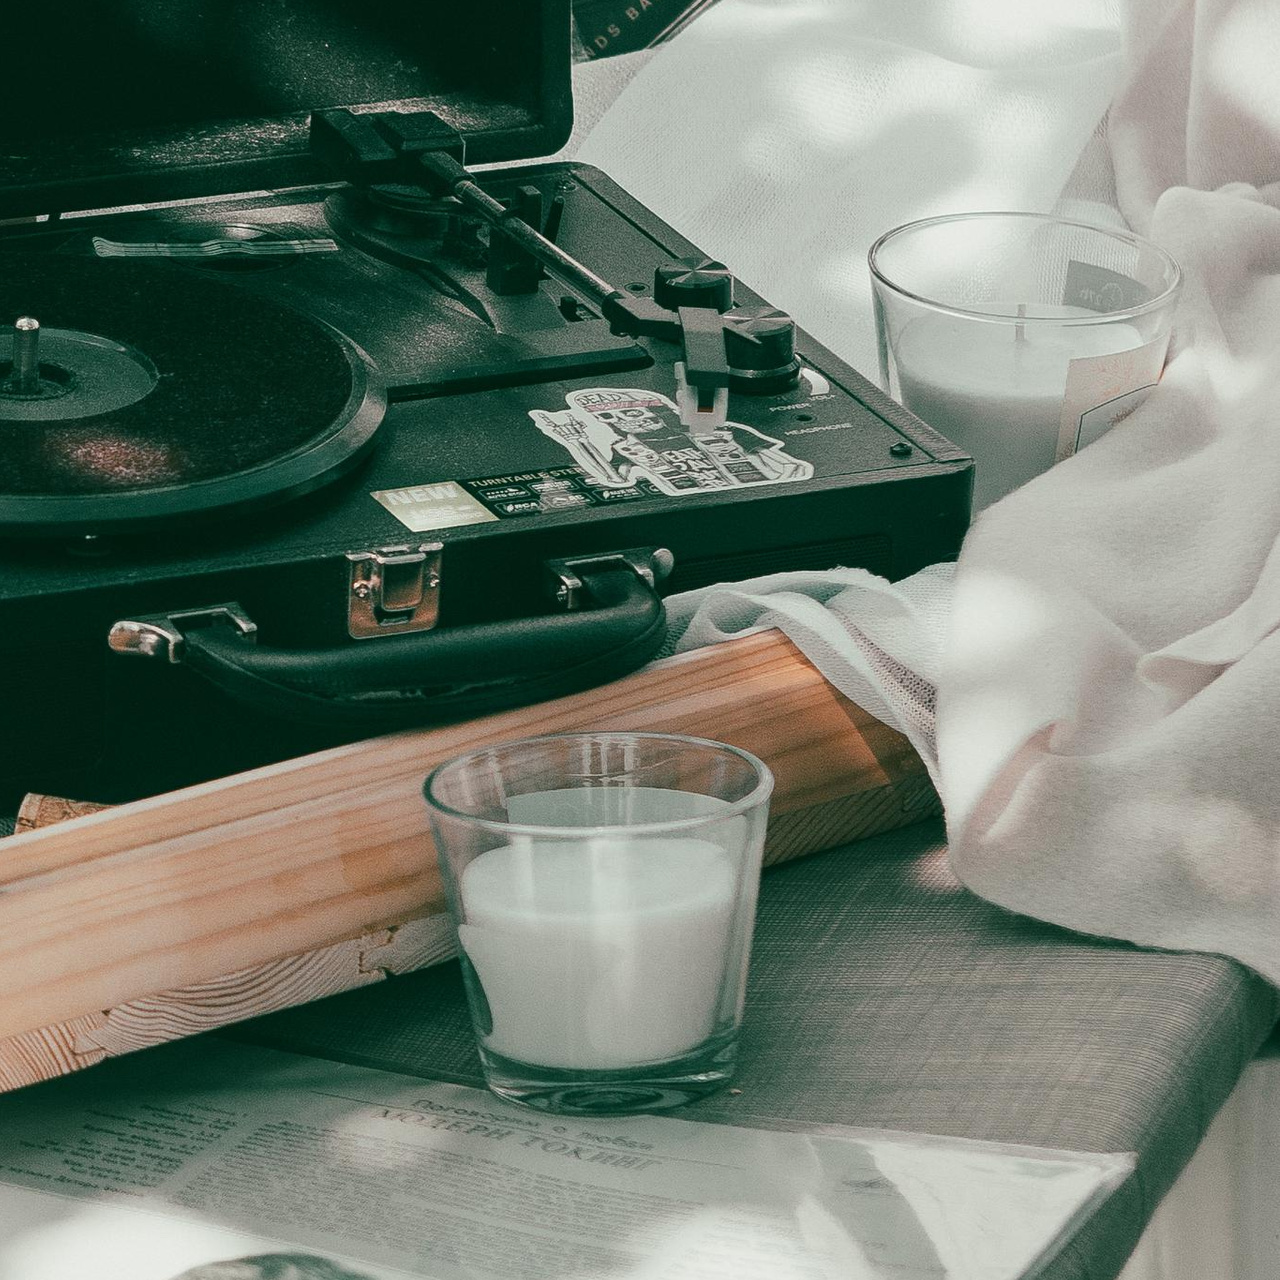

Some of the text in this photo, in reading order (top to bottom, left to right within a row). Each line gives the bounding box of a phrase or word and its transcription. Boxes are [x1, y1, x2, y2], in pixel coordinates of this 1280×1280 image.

[769, 402, 812, 412] POWER
[467, 471, 550, 488] TURNTABLE
[384, 483, 458, 506] NEW
